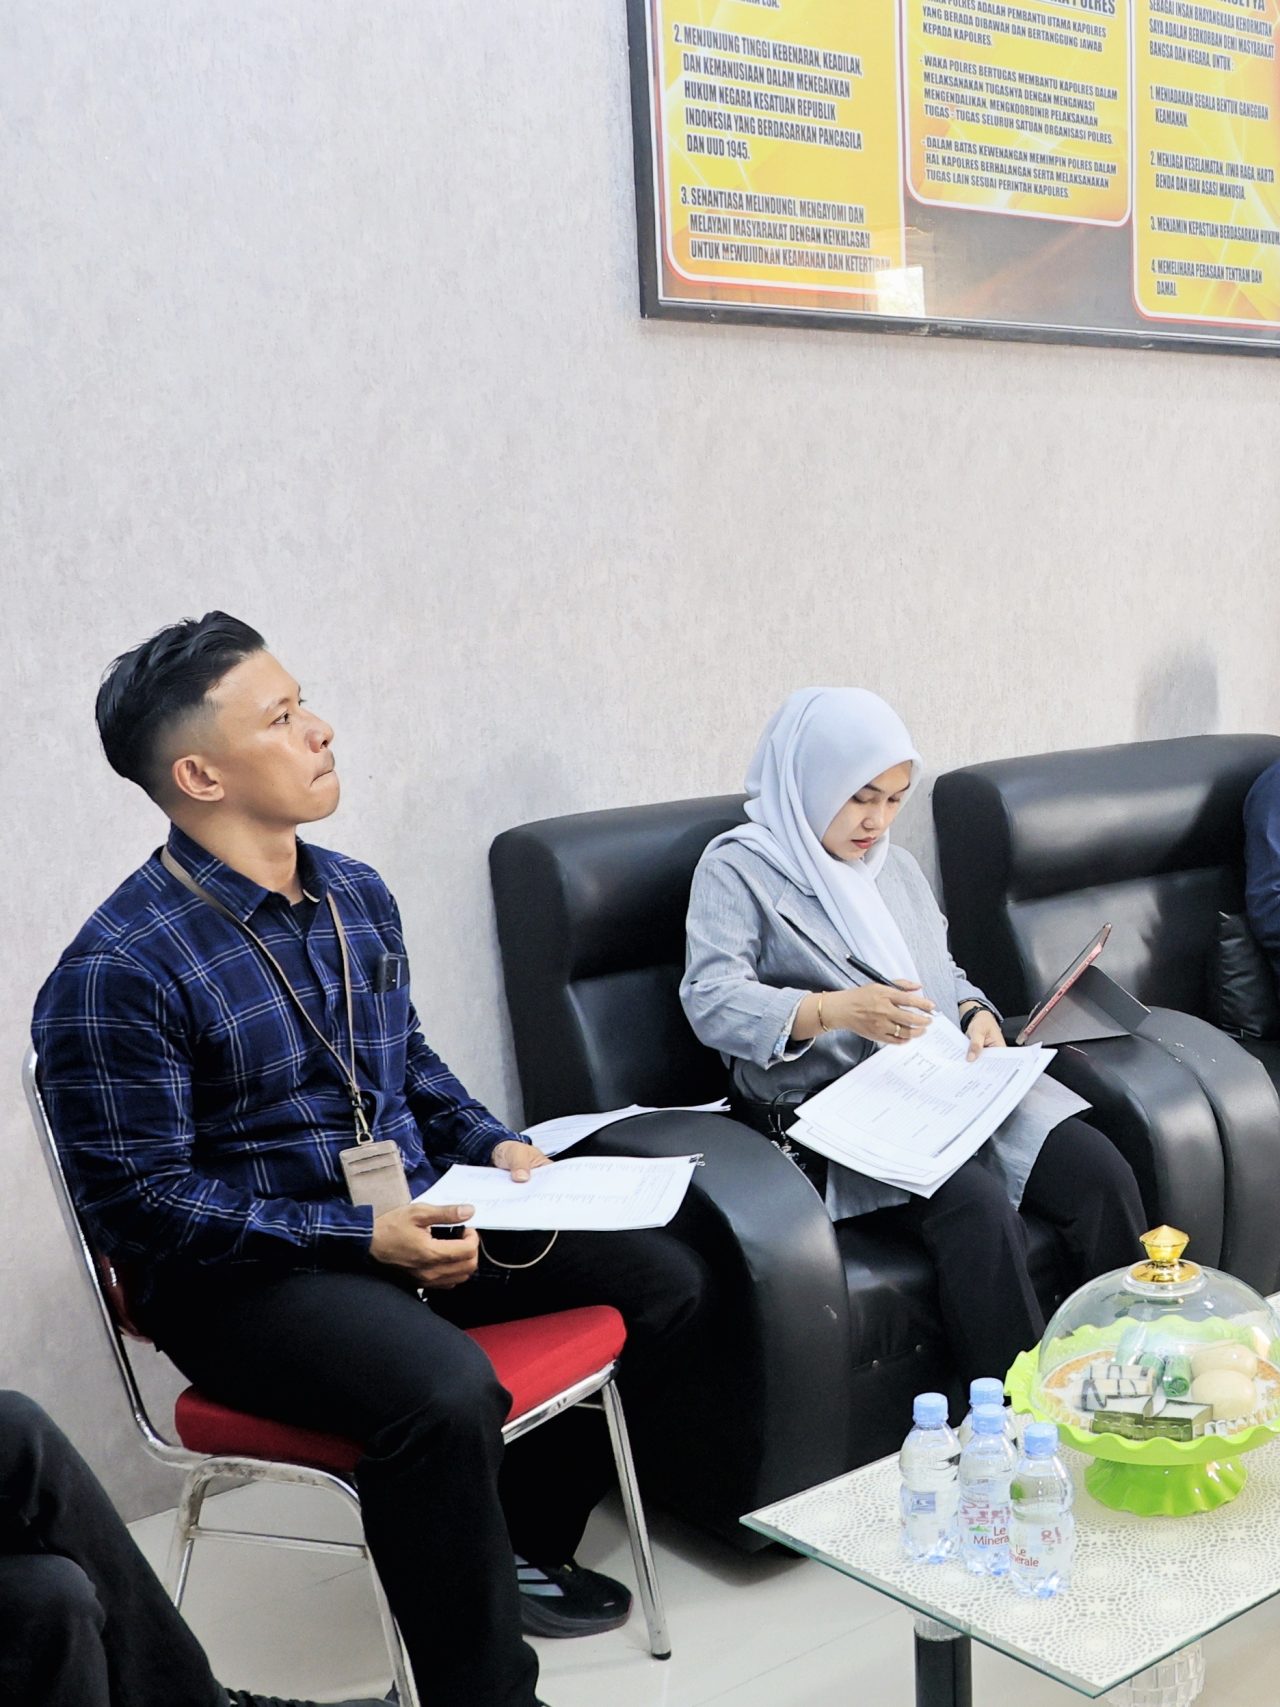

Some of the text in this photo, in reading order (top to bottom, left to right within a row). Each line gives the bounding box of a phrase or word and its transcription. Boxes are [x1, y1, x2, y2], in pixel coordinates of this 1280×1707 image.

[977, 1, 1006, 16] ADALAH
[1007, 8, 1046, 25] PEMBANTU
[1047, 16, 1071, 30] UTAMA
[1073, 21, 1106, 38] KAPOLRES
[1176, 2, 1193, 20] INSAN
[674, 24, 682, 43] 2.
[684, 26, 740, 53] MENJUNJUNG
[742, 37, 770, 58] TINGGI
[923, 6, 1102, 52] YANG BERADA DIBAWAH DAN BERTANGGUNG JAWAB
[923, 22, 952, 38] KEPADA
[1149, 18, 1274, 59] SAYA ADALAH BERKORBAN DEMI MASYARAKAT
[1150, 40, 1173, 59] BANGSA
[1175, 46, 1186, 62] DAN
[1212, 54, 1231, 71] UNTUK
[683, 53, 850, 98] DAN KEMANUSIAAN DALAM MENEGAKKAN
[924, 55, 1117, 100] WAKA POLRES BERTUGAS MEMBANTU KAPOLRES DALAM
[684, 80, 836, 120] HUKUM NEGARA KESATUAN REPUBLIK
[924, 72, 1095, 111] MELAKSANAKAN TUGASNYA DENGAN MENGAWASI
[1194, 93, 1215, 110] SEGALA
[1217, 98, 1238, 114] BENTUK
[1239, 101, 1268, 120] GANGGUAN
[686, 107, 862, 150] INDONESIA YANG BERDASARKAN PANCASILA
[925, 104, 949, 119] TUGAS
[956, 109, 980, 124] TUGAS
[982, 114, 1014, 129] SELURUH
[1016, 119, 1042, 133] SATUAN
[1044, 124, 1086, 140] ORGANISASI
[990, 99, 1049, 119] MENGKOORDINIR
[1051, 110, 1098, 127] PELAKSANAAN
[687, 134, 750, 160] DAN UUD 1945.
[926, 137, 1116, 174] DALAM BATAS KEWENANGAN MEMIMPIN POLRES DALAM
[926, 153, 1109, 188] HAL KAPOLRES BERHALANGAN SERTA MELAKSANAKAN
[926, 169, 951, 182] TUGAS
[953, 172, 969, 185] LAIN
[971, 175, 997, 189] SESUAI
[998, 179, 1032, 193] PERINTAH
[1157, 152, 1183, 170] MENJAGA
[1226, 162, 1238, 177] JIWA
[1257, 168, 1274, 183] HARTA
[1155, 174, 1174, 190] BENDA
[1176, 176, 1187, 192] DAN
[1189, 178, 1200, 193] HAK
[1202, 180, 1218, 196] ASASI
[681, 186, 689, 204] 3.
[691, 187, 744, 210] SENANTIASA
[800, 200, 846, 222] MENGAYOMI
[849, 206, 864, 224] DAN
[690, 214, 870, 248] MELAYANI MASYARAKAT DENGAN KEIKHLASAN
[1157, 217, 1187, 233] MENJAMIN
[1188, 221, 1218, 238] KEPASTIAN
[1220, 225, 1259, 242] BERDASARKAN
[691, 240, 720, 259] UNTUK
[722, 243, 780, 265] MEWUJUDKAN
[783, 249, 825, 269] KEAMANAN
[828, 253, 843, 271] DAN
[1158, 260, 1194, 276] MEMELIHARA
[1196, 265, 1224, 279] PERASAAN
[1226, 267, 1250, 282] TENTRAM
[1251, 270, 1262, 283] DAN
[973, 1535, 1010, 1546] Minera
[993, 1526, 1007, 1537] Le
[1009, 1550, 1040, 1568] erale
